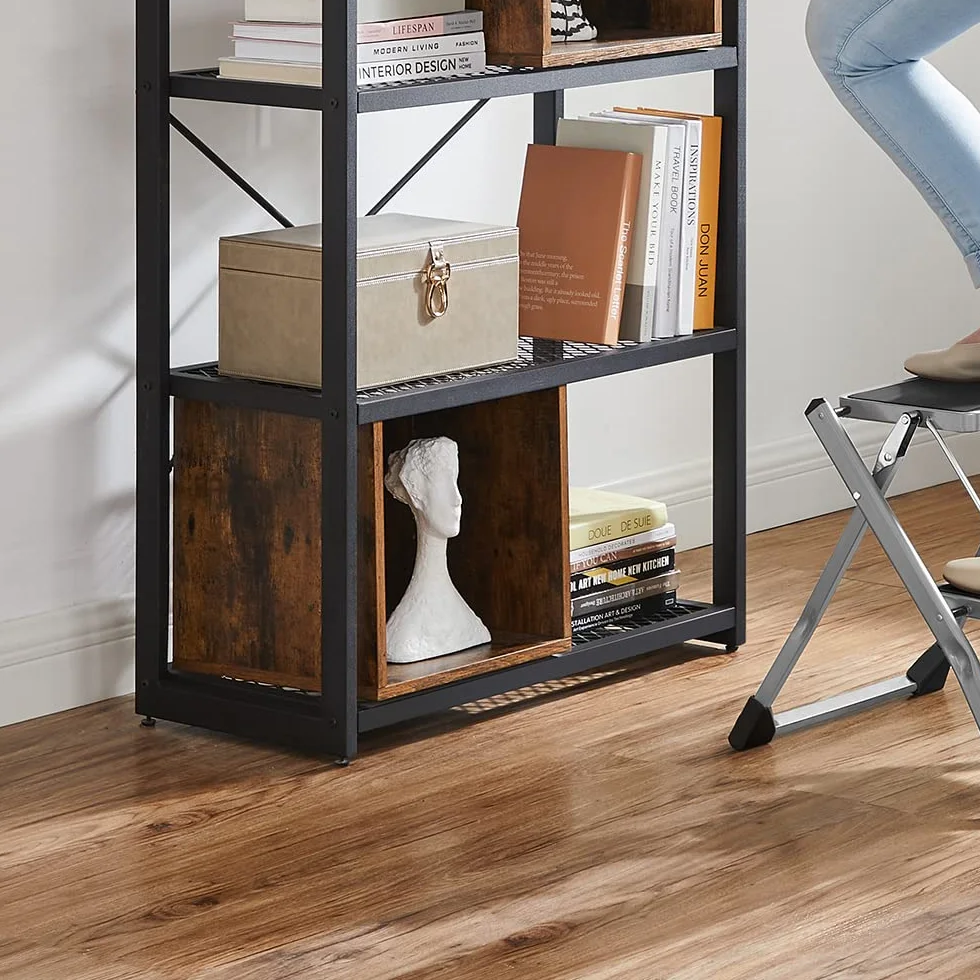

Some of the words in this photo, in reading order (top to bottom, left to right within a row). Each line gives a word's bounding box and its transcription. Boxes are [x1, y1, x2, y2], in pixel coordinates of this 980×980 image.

[392, 22, 435, 35] LIFESPAN
[373, 45, 408, 55] MODERN
[412, 42, 439, 52] LIVING
[359, 62, 412, 80] INTERIOR
[415, 58, 457, 74] DESIGN
[653, 160, 662, 196] MAKE
[671, 146, 681, 182] TRAVEL
[670, 186, 679, 214] BOOK
[687, 144, 699, 226] INSPIRATIONS
[620, 221, 630, 242] The
[650, 202, 659, 237] YOUR
[699, 223, 710, 255] DON
[615, 244, 627, 285] Scarlet
[648, 243, 656, 266] BED
[698, 259, 709, 298] JUAN
[611, 285, 622, 320] Letter
[588, 525, 612, 541] DOUE
[620, 520, 632, 532] DE
[633, 515, 651, 529] SUIE
[578, 576, 591, 590] ART
[592, 572, 607, 586] NEW
[608, 567, 627, 581] HOME
[627, 563, 641, 576] NEW
[642, 555, 670, 572] KITCHEN
[581, 556, 599, 568] YOU
[599, 551, 618, 563] CAN
[604, 610, 615, 619] ART
[620, 604, 641, 615] DESIGN
